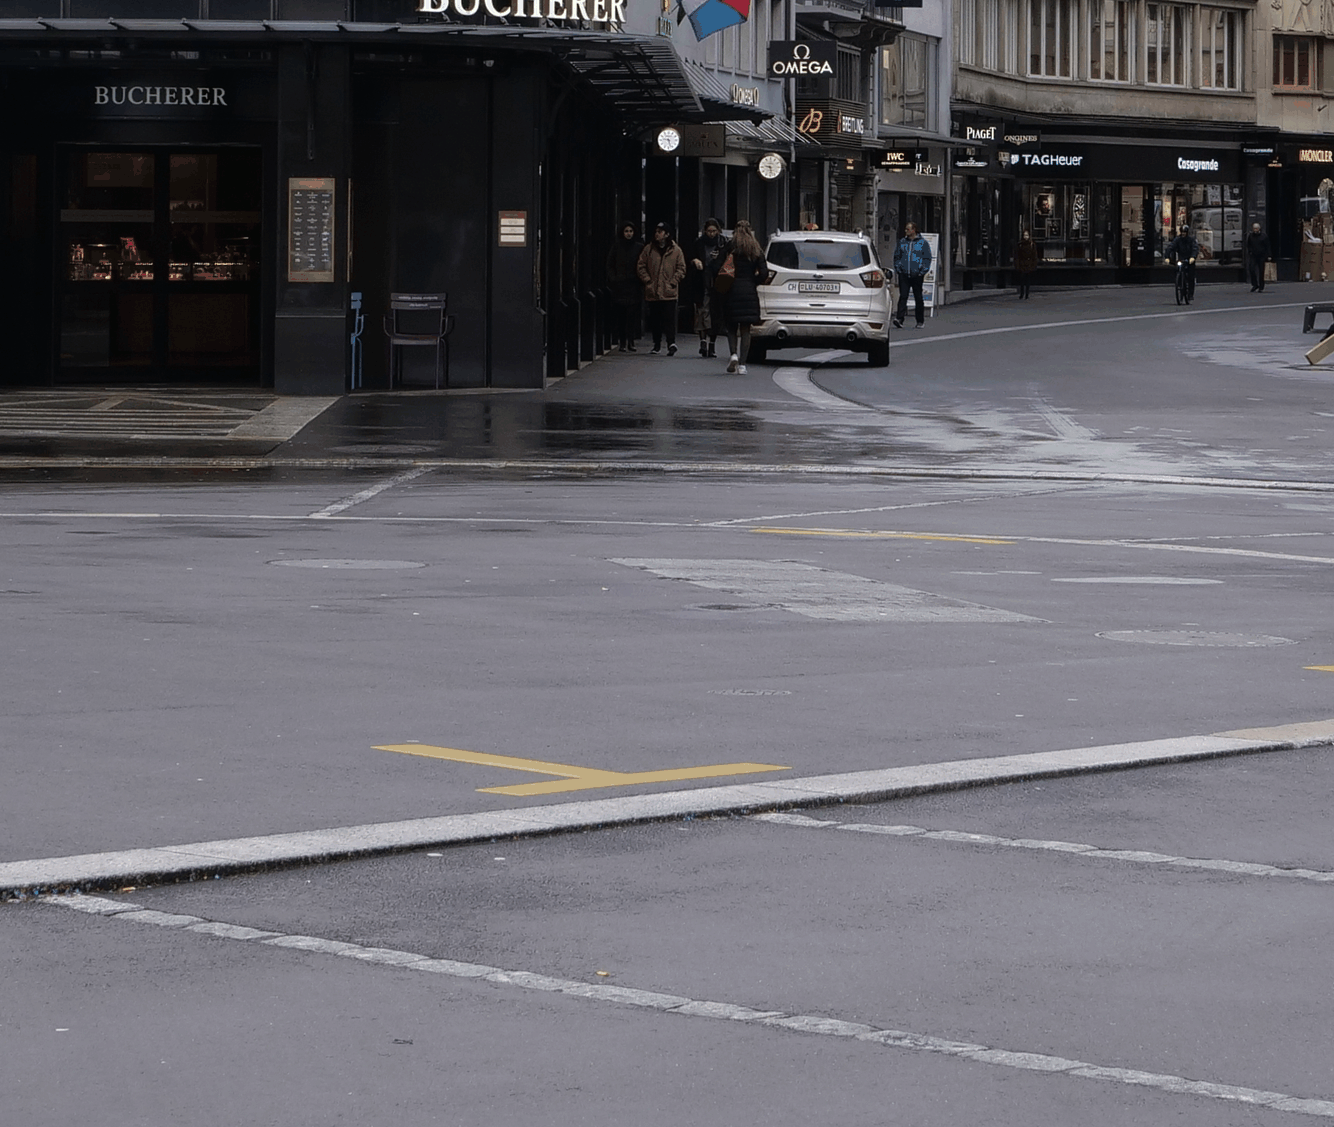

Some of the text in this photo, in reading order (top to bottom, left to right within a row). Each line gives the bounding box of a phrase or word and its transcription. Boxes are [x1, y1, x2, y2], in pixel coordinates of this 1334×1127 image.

[772, 60, 833, 74] OMEGA
[93, 86, 228, 107] BUCHERER
[966, 126, 997, 140] PIAGET
[886, 152, 905, 162] IWC
[1021, 154, 1083, 167] TAGHeuer
[1299, 149, 1334, 163] MONCLER
[1177, 157, 1219, 172] Casagrande
